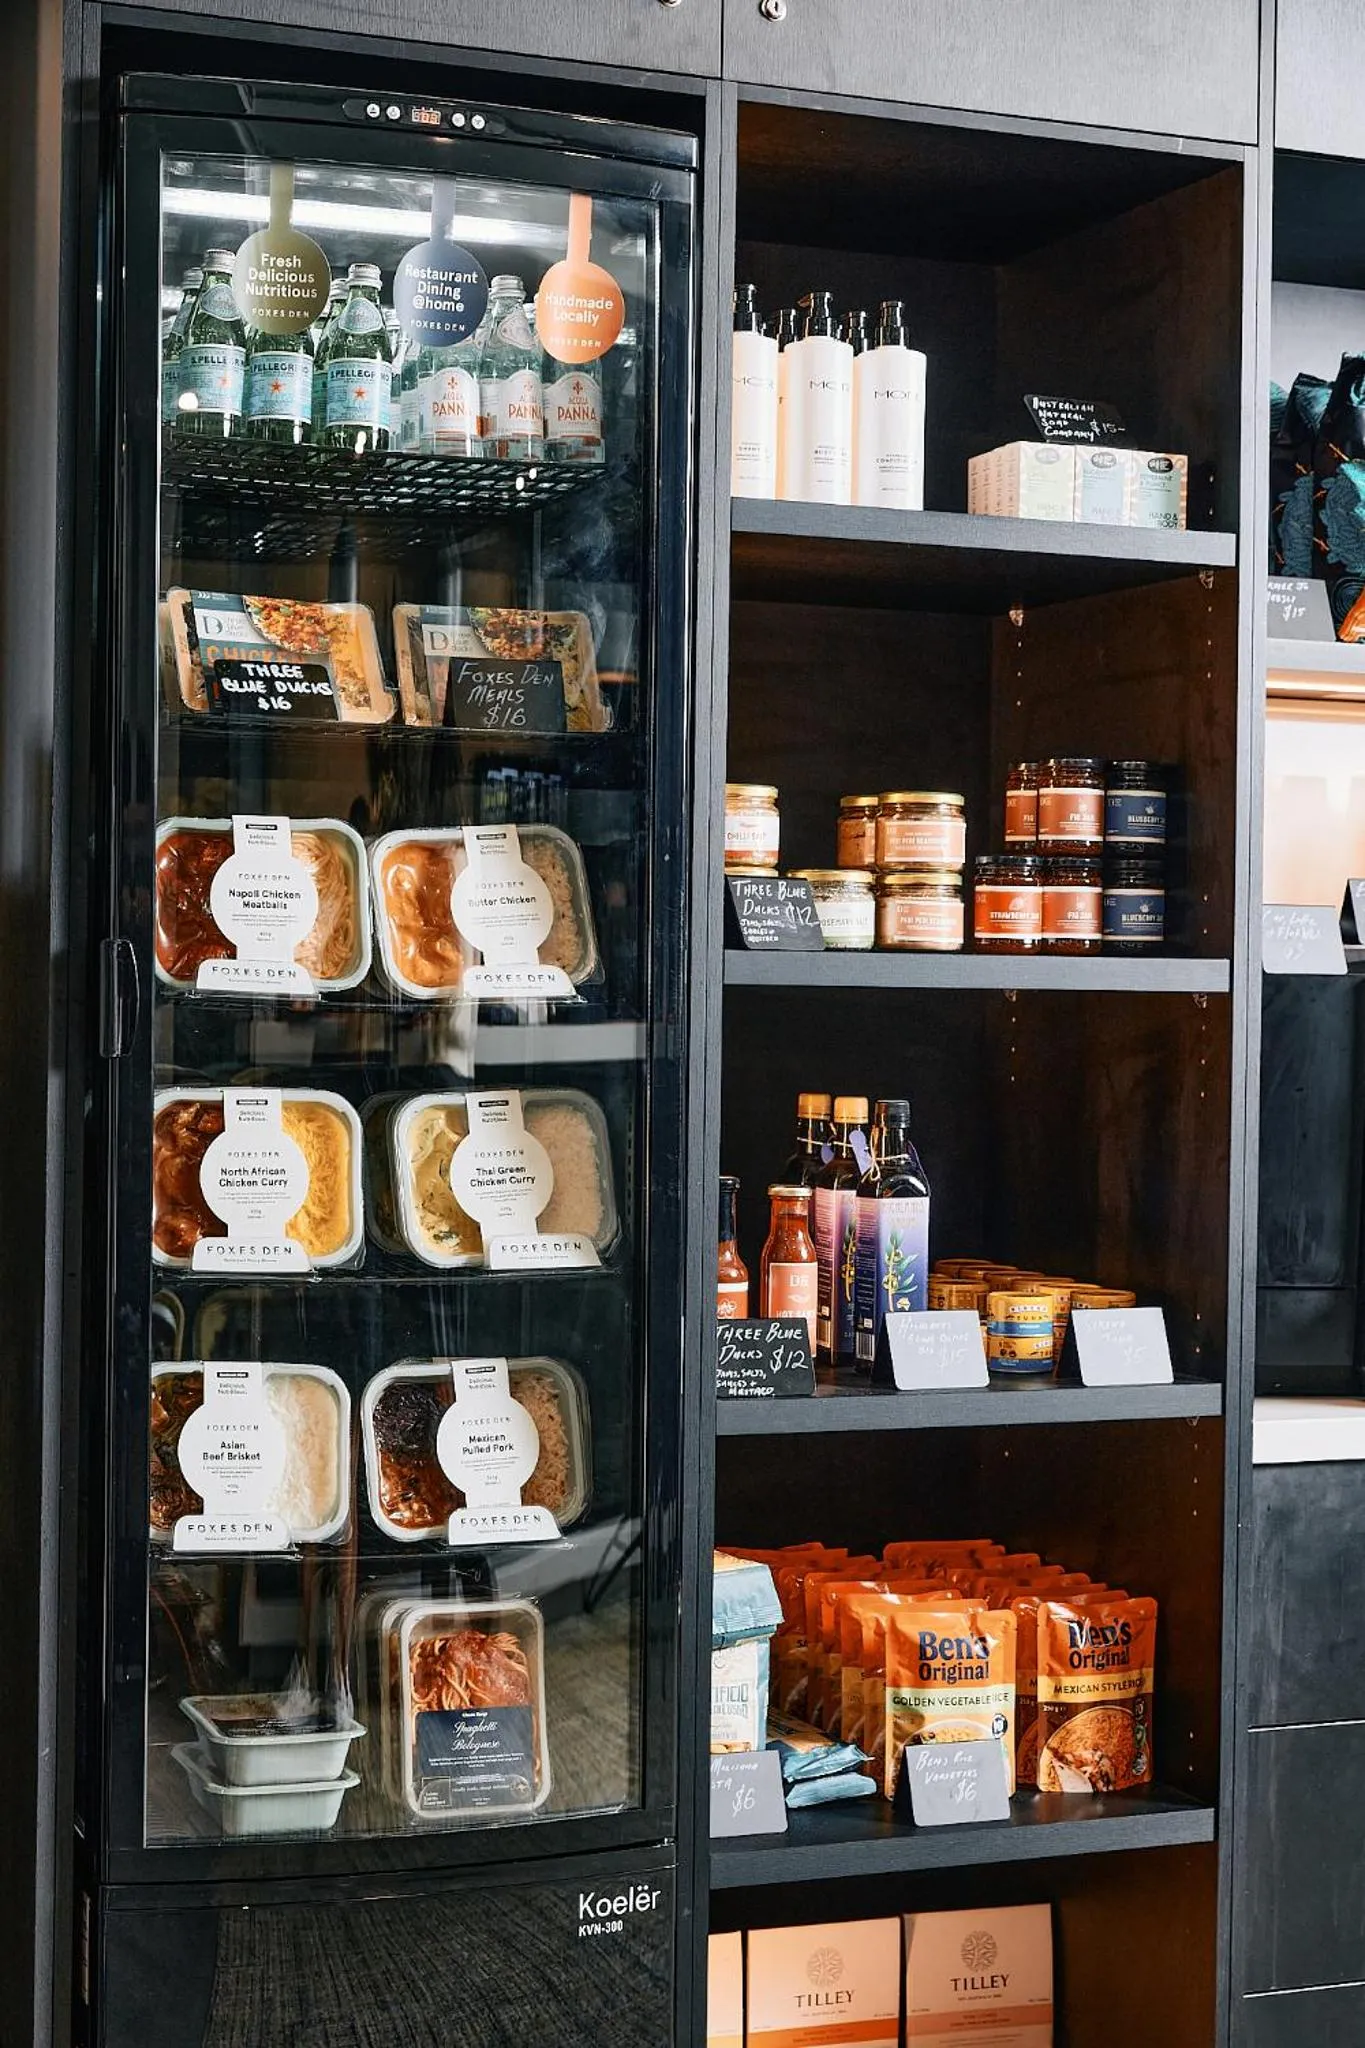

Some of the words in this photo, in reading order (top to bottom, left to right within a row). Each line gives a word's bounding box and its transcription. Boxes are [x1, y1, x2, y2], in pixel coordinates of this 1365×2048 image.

[261, 252, 302, 268] Fresh
[248, 267, 315, 284] Delicious
[405, 263, 479, 285] Restaurant
[245, 283, 318, 299] Nutritious
[417, 281, 462, 301] Dining
[412, 295, 465, 313] @home
[545, 293, 614, 310] Handmade
[288, 309, 310, 318] DEN
[553, 309, 600, 327] Locally
[444, 321, 466, 332] DEN
[1032, 396, 1095, 413] AUSTRALIAN
[557, 405, 598, 421] PANNA
[1038, 409, 1086, 422] NATURAL
[1040, 418, 1069, 429] SOAP
[1044, 425, 1095, 443] COMPANY
[240, 663, 304, 679] THREE
[457, 661, 515, 684] FOXES
[520, 664, 555, 686] DEN
[221, 677, 268, 694] BLUE
[274, 680, 335, 696] DUCKS
[257, 696, 292, 711] $16
[467, 686, 526, 705] MEALS
[483, 704, 527, 727] $16
[228, 889, 260, 901] Napoli
[261, 889, 301, 900] Chicken
[731, 879, 774, 900] THREE
[777, 880, 808, 901] BLUE
[242, 899, 288, 910] Meatballs
[468, 896, 498, 908] Butter
[499, 895, 537, 906] Chicken
[742, 898, 780, 916] DUCKS
[211, 966, 261, 977] FOXES
[267, 969, 297, 979] DEN
[475, 973, 523, 983] FOXES
[527, 974, 556, 984] DEN
[220, 1167, 250, 1177] North
[250, 1167, 286, 1177] African
[476, 1166, 496, 1177] Thai
[497, 1165, 526, 1176] Green
[219, 1178, 259, 1188] Chicken
[261, 1178, 289, 1189] Curry
[470, 1176, 508, 1188] Chicken
[509, 1174, 536, 1186] Curry
[206, 1246, 256, 1255] FOXES
[262, 1246, 292, 1256] DEN
[501, 1243, 548, 1254] FOXES
[553, 1242, 582, 1252] DEN
[716, 1323, 763, 1344] THREE
[765, 1322, 803, 1343] BLUE
[719, 1344, 763, 1365] DUCKS
[769, 1344, 809, 1374] $12
[220, 1440, 246, 1450] Asian
[469, 1433, 506, 1445] Mexican
[202, 1452, 225, 1462] Beef
[227, 1451, 261, 1461] Brisket
[462, 1445, 491, 1456] Pulled
[493, 1443, 515, 1453] Pork
[188, 1524, 237, 1533] FOXES
[243, 1523, 273, 1533] DEN
[460, 1516, 509, 1527] FOXES
[513, 1514, 542, 1525] DEN
[1068, 1617, 1132, 1649] Ben's
[918, 1630, 990, 1661] Ben's
[1069, 1649, 1130, 1671] Original
[918, 1661, 990, 1686] Original
[1053, 1682, 1100, 1695] MEXICAN
[1101, 1679, 1128, 1692] STYLE
[893, 1695, 936, 1707] GOLDEN
[938, 1694, 991, 1706] VEGETABLE
[452, 1719, 499, 1738] Spaghetti
[954, 1778, 978, 1804] $6
[732, 1784, 756, 1818] $6
[579, 1884, 662, 1920] Koelër
[578, 1920, 624, 1937] KVN-300
[951, 1974, 1010, 1993] TILLEY
[794, 1990, 855, 2009] TILLEY
